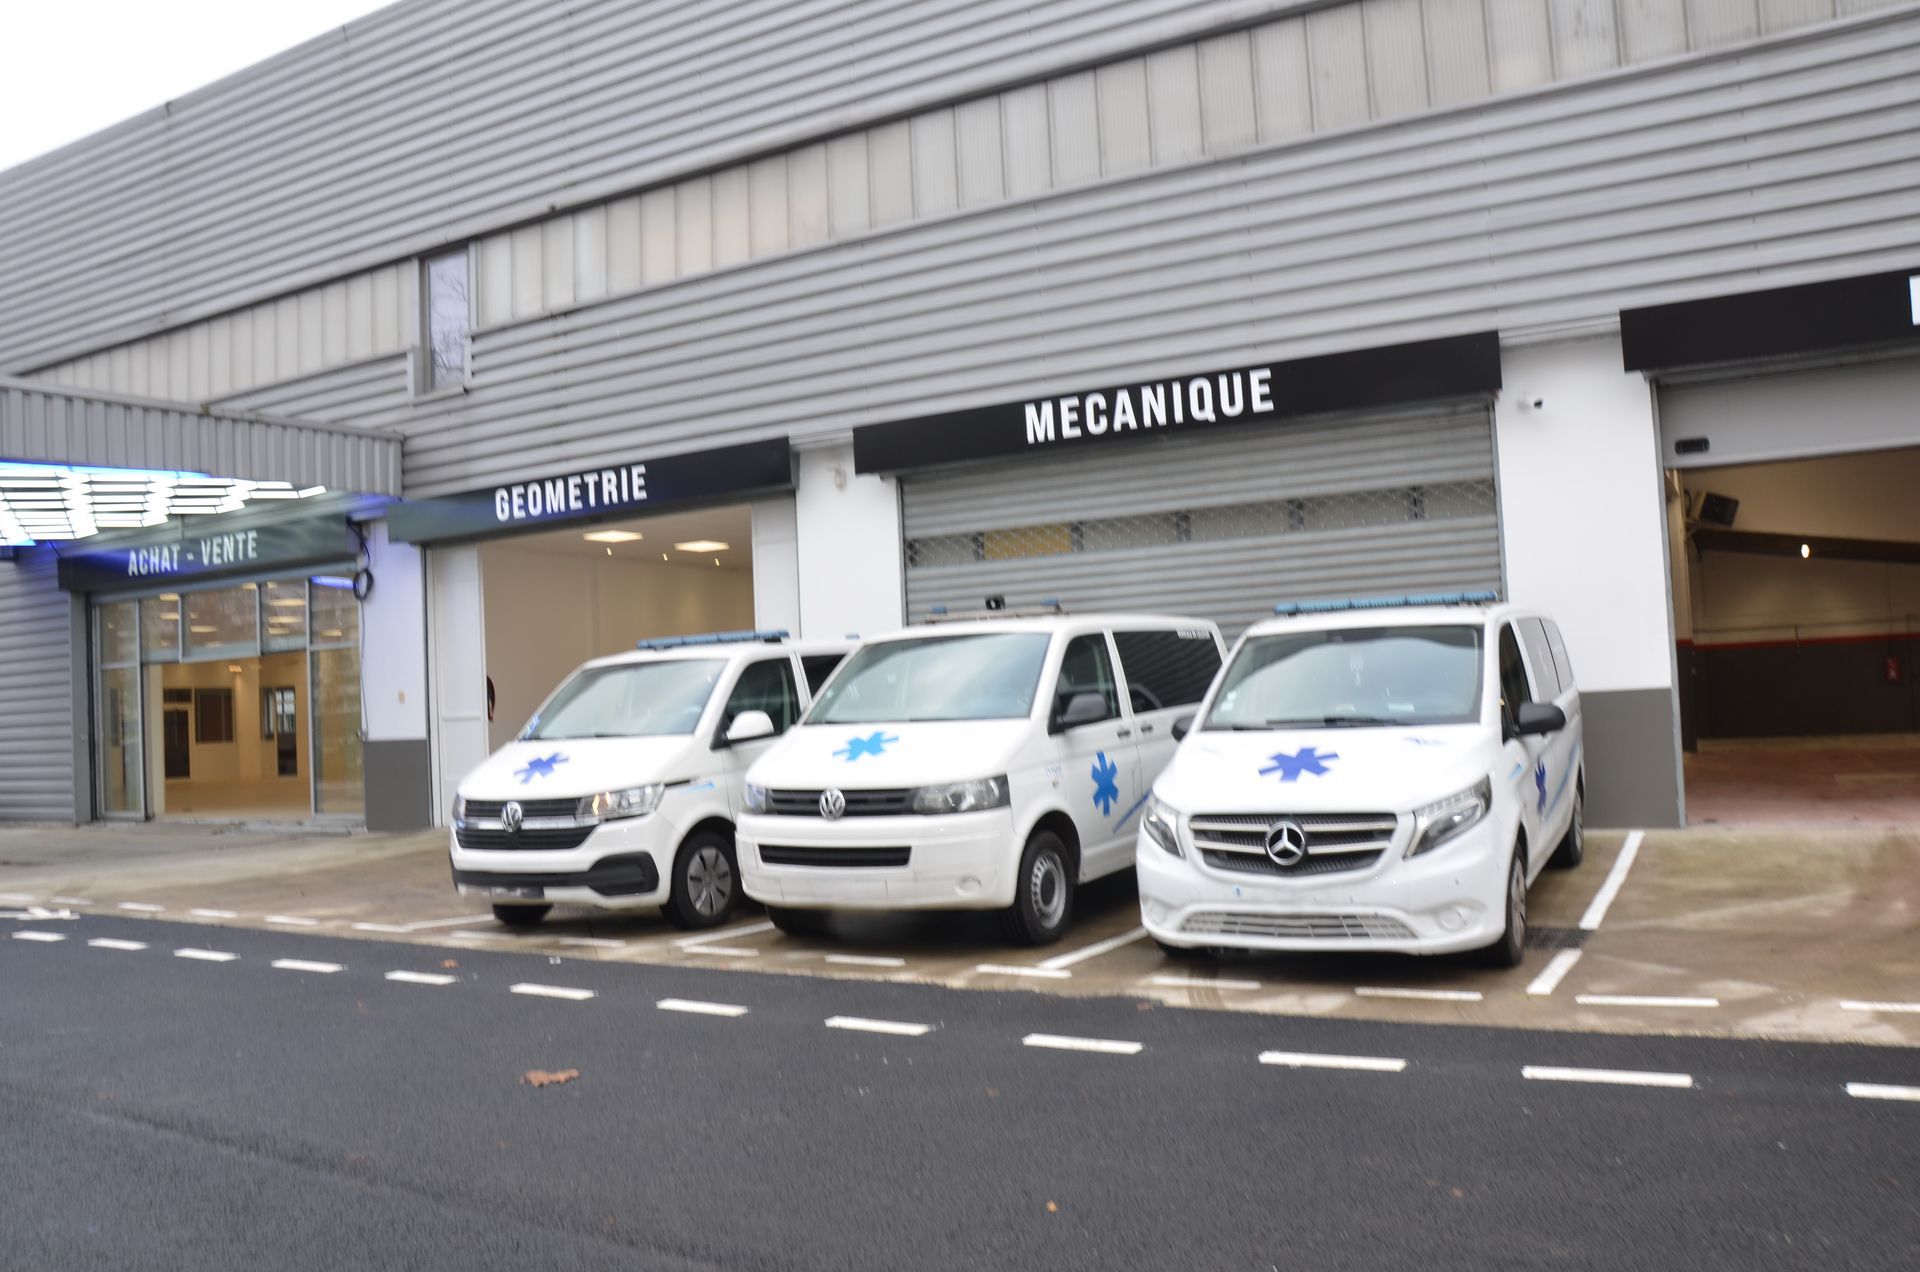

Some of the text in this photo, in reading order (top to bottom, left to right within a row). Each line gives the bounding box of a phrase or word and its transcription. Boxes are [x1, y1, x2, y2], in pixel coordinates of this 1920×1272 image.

[1024, 368, 1275, 443] MECANIQUE
[495, 464, 648, 521] GEOMETRIE
[128, 545, 181, 577] ACHAT
[200, 530, 259, 566] VENTE
